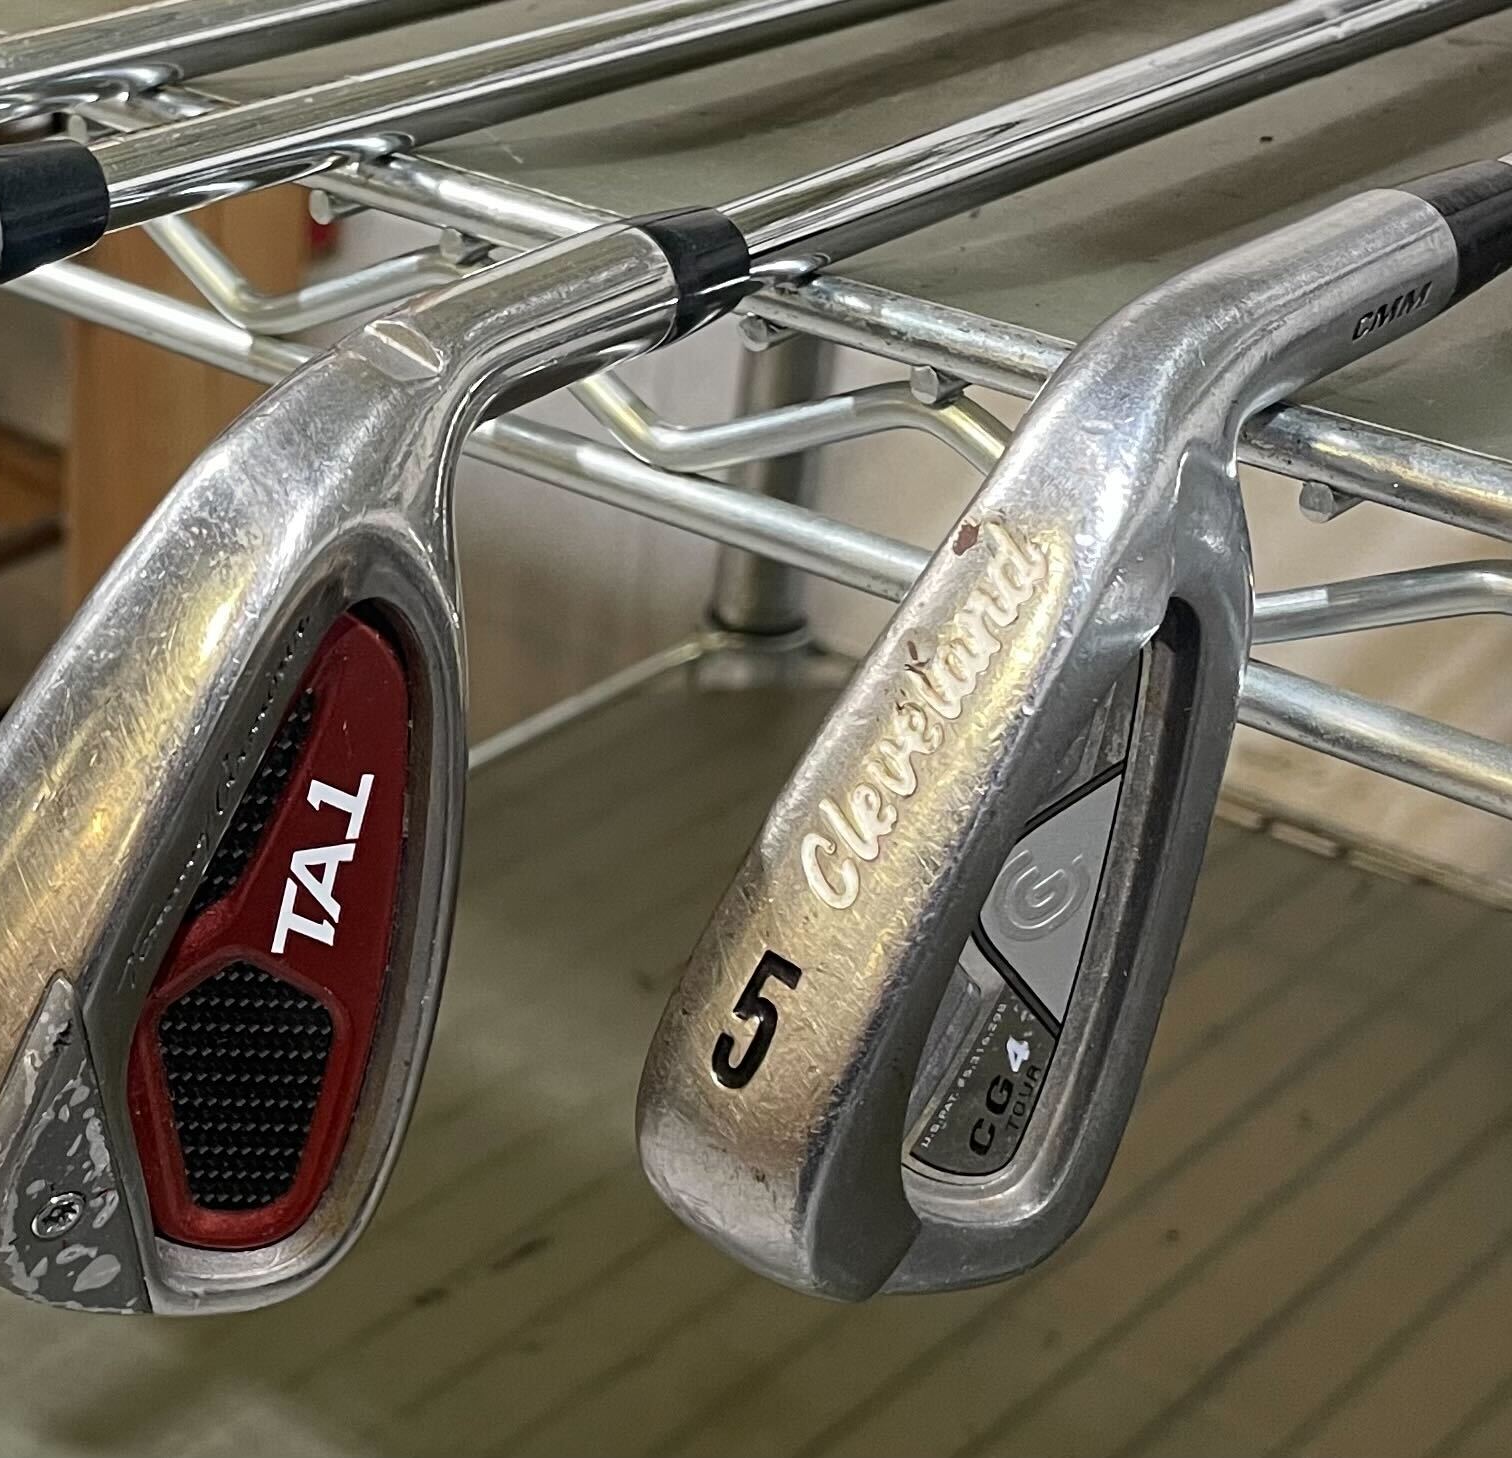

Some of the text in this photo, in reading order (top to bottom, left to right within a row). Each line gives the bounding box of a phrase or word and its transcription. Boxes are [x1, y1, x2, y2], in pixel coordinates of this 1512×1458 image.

[1351, 280, 1433, 343] CMM
[799, 519, 1048, 911] Cleveland
[270, 773, 375, 954] TA1
[709, 948, 802, 1089] 5
[1007, 1064, 1042, 1131] TOUR
